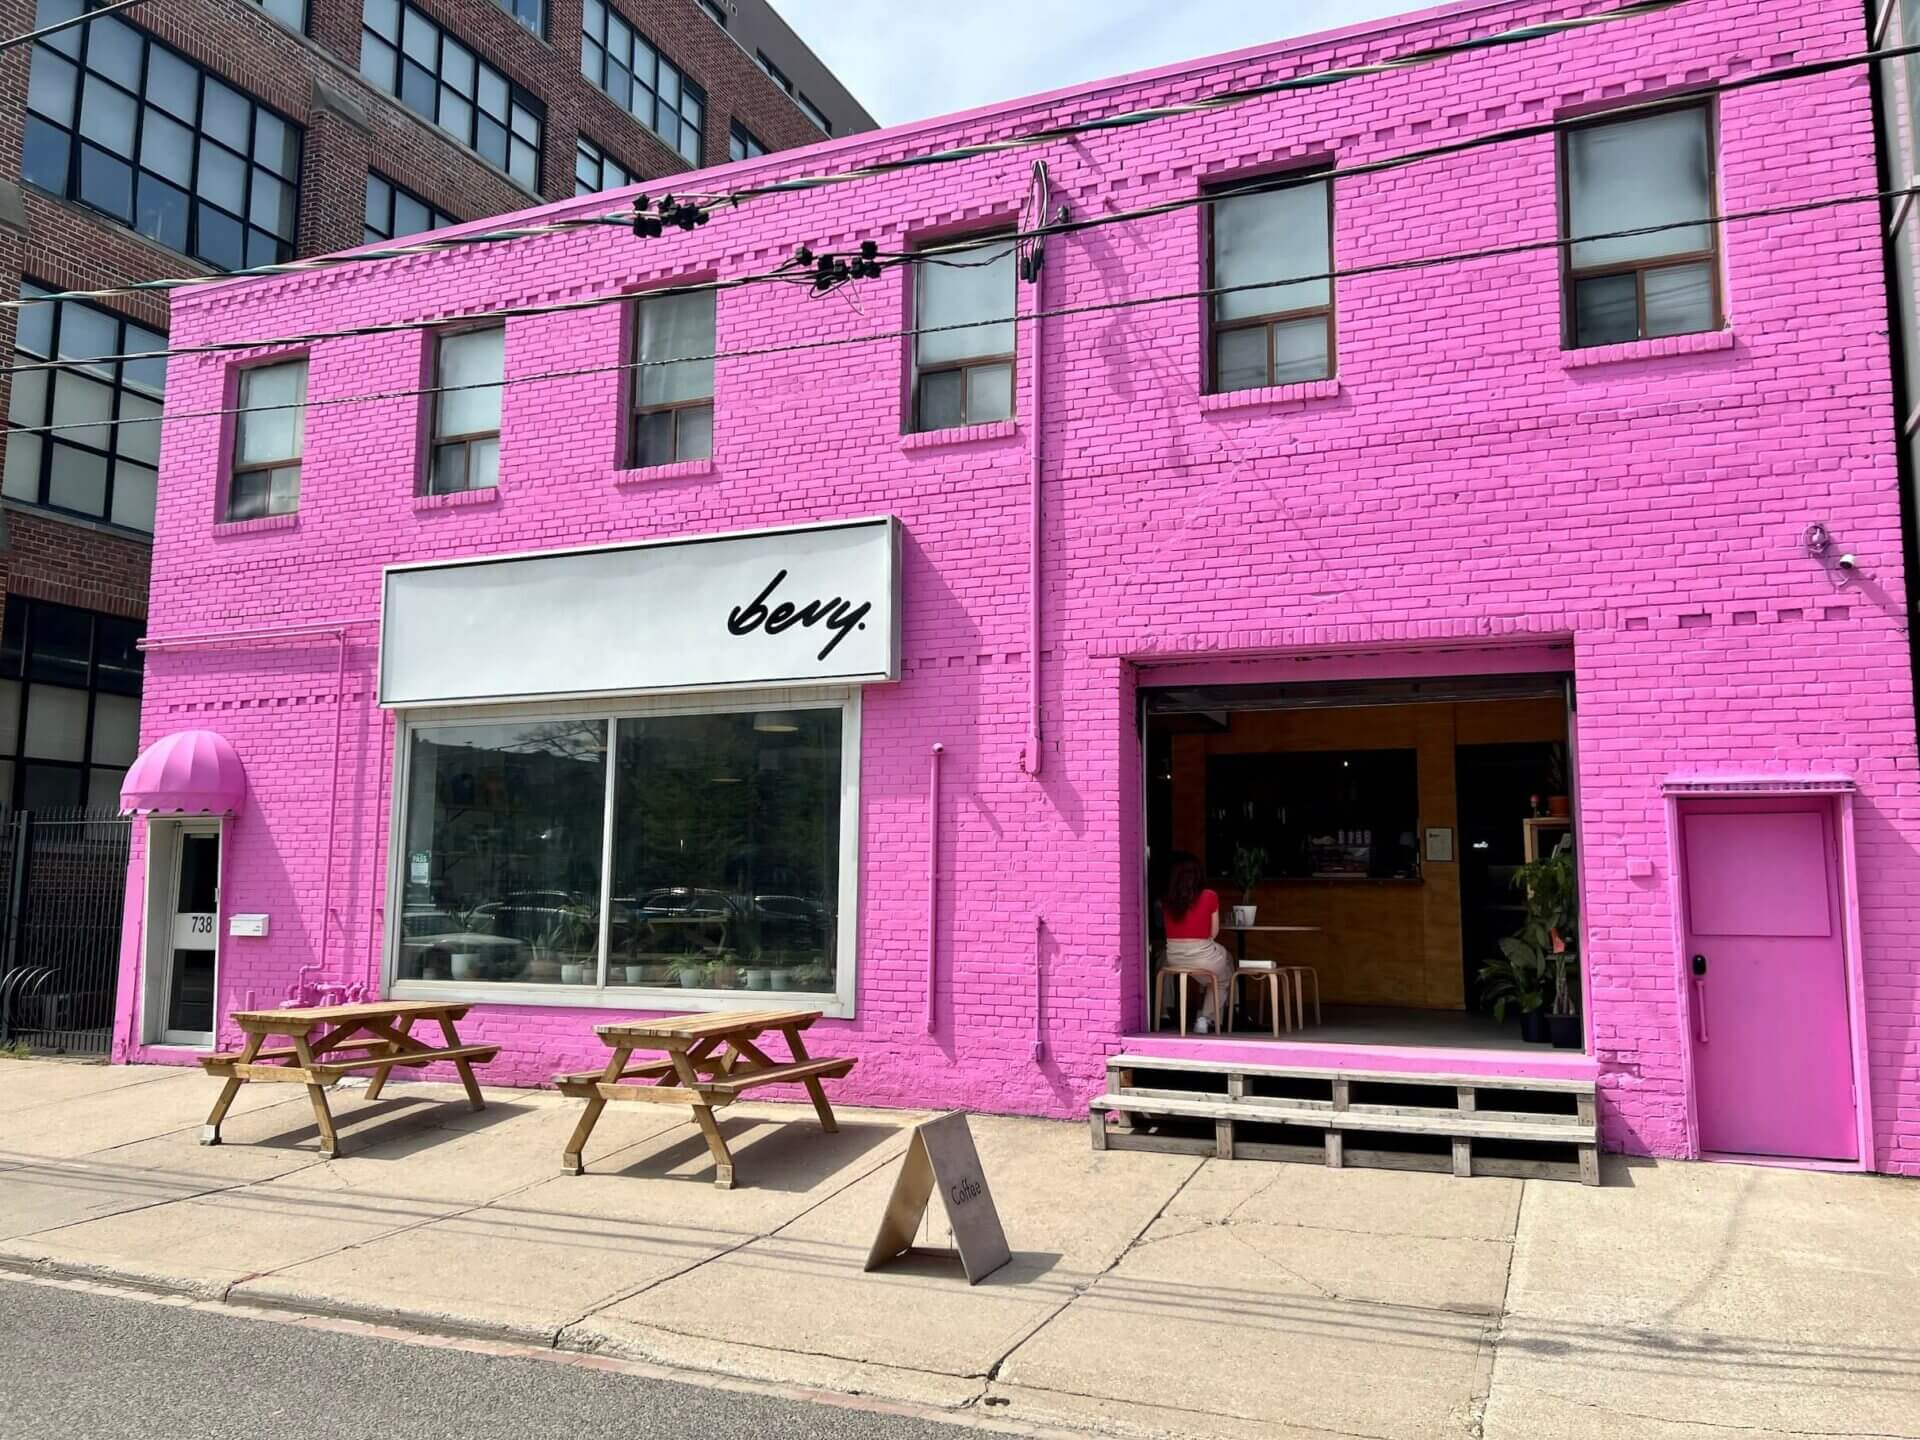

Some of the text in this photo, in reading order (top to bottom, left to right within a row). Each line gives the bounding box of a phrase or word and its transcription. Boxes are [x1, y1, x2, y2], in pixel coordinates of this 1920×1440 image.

[728, 569, 872, 661] bevy.
[192, 916, 212, 933] 738
[951, 1177, 981, 1205] Coffee
